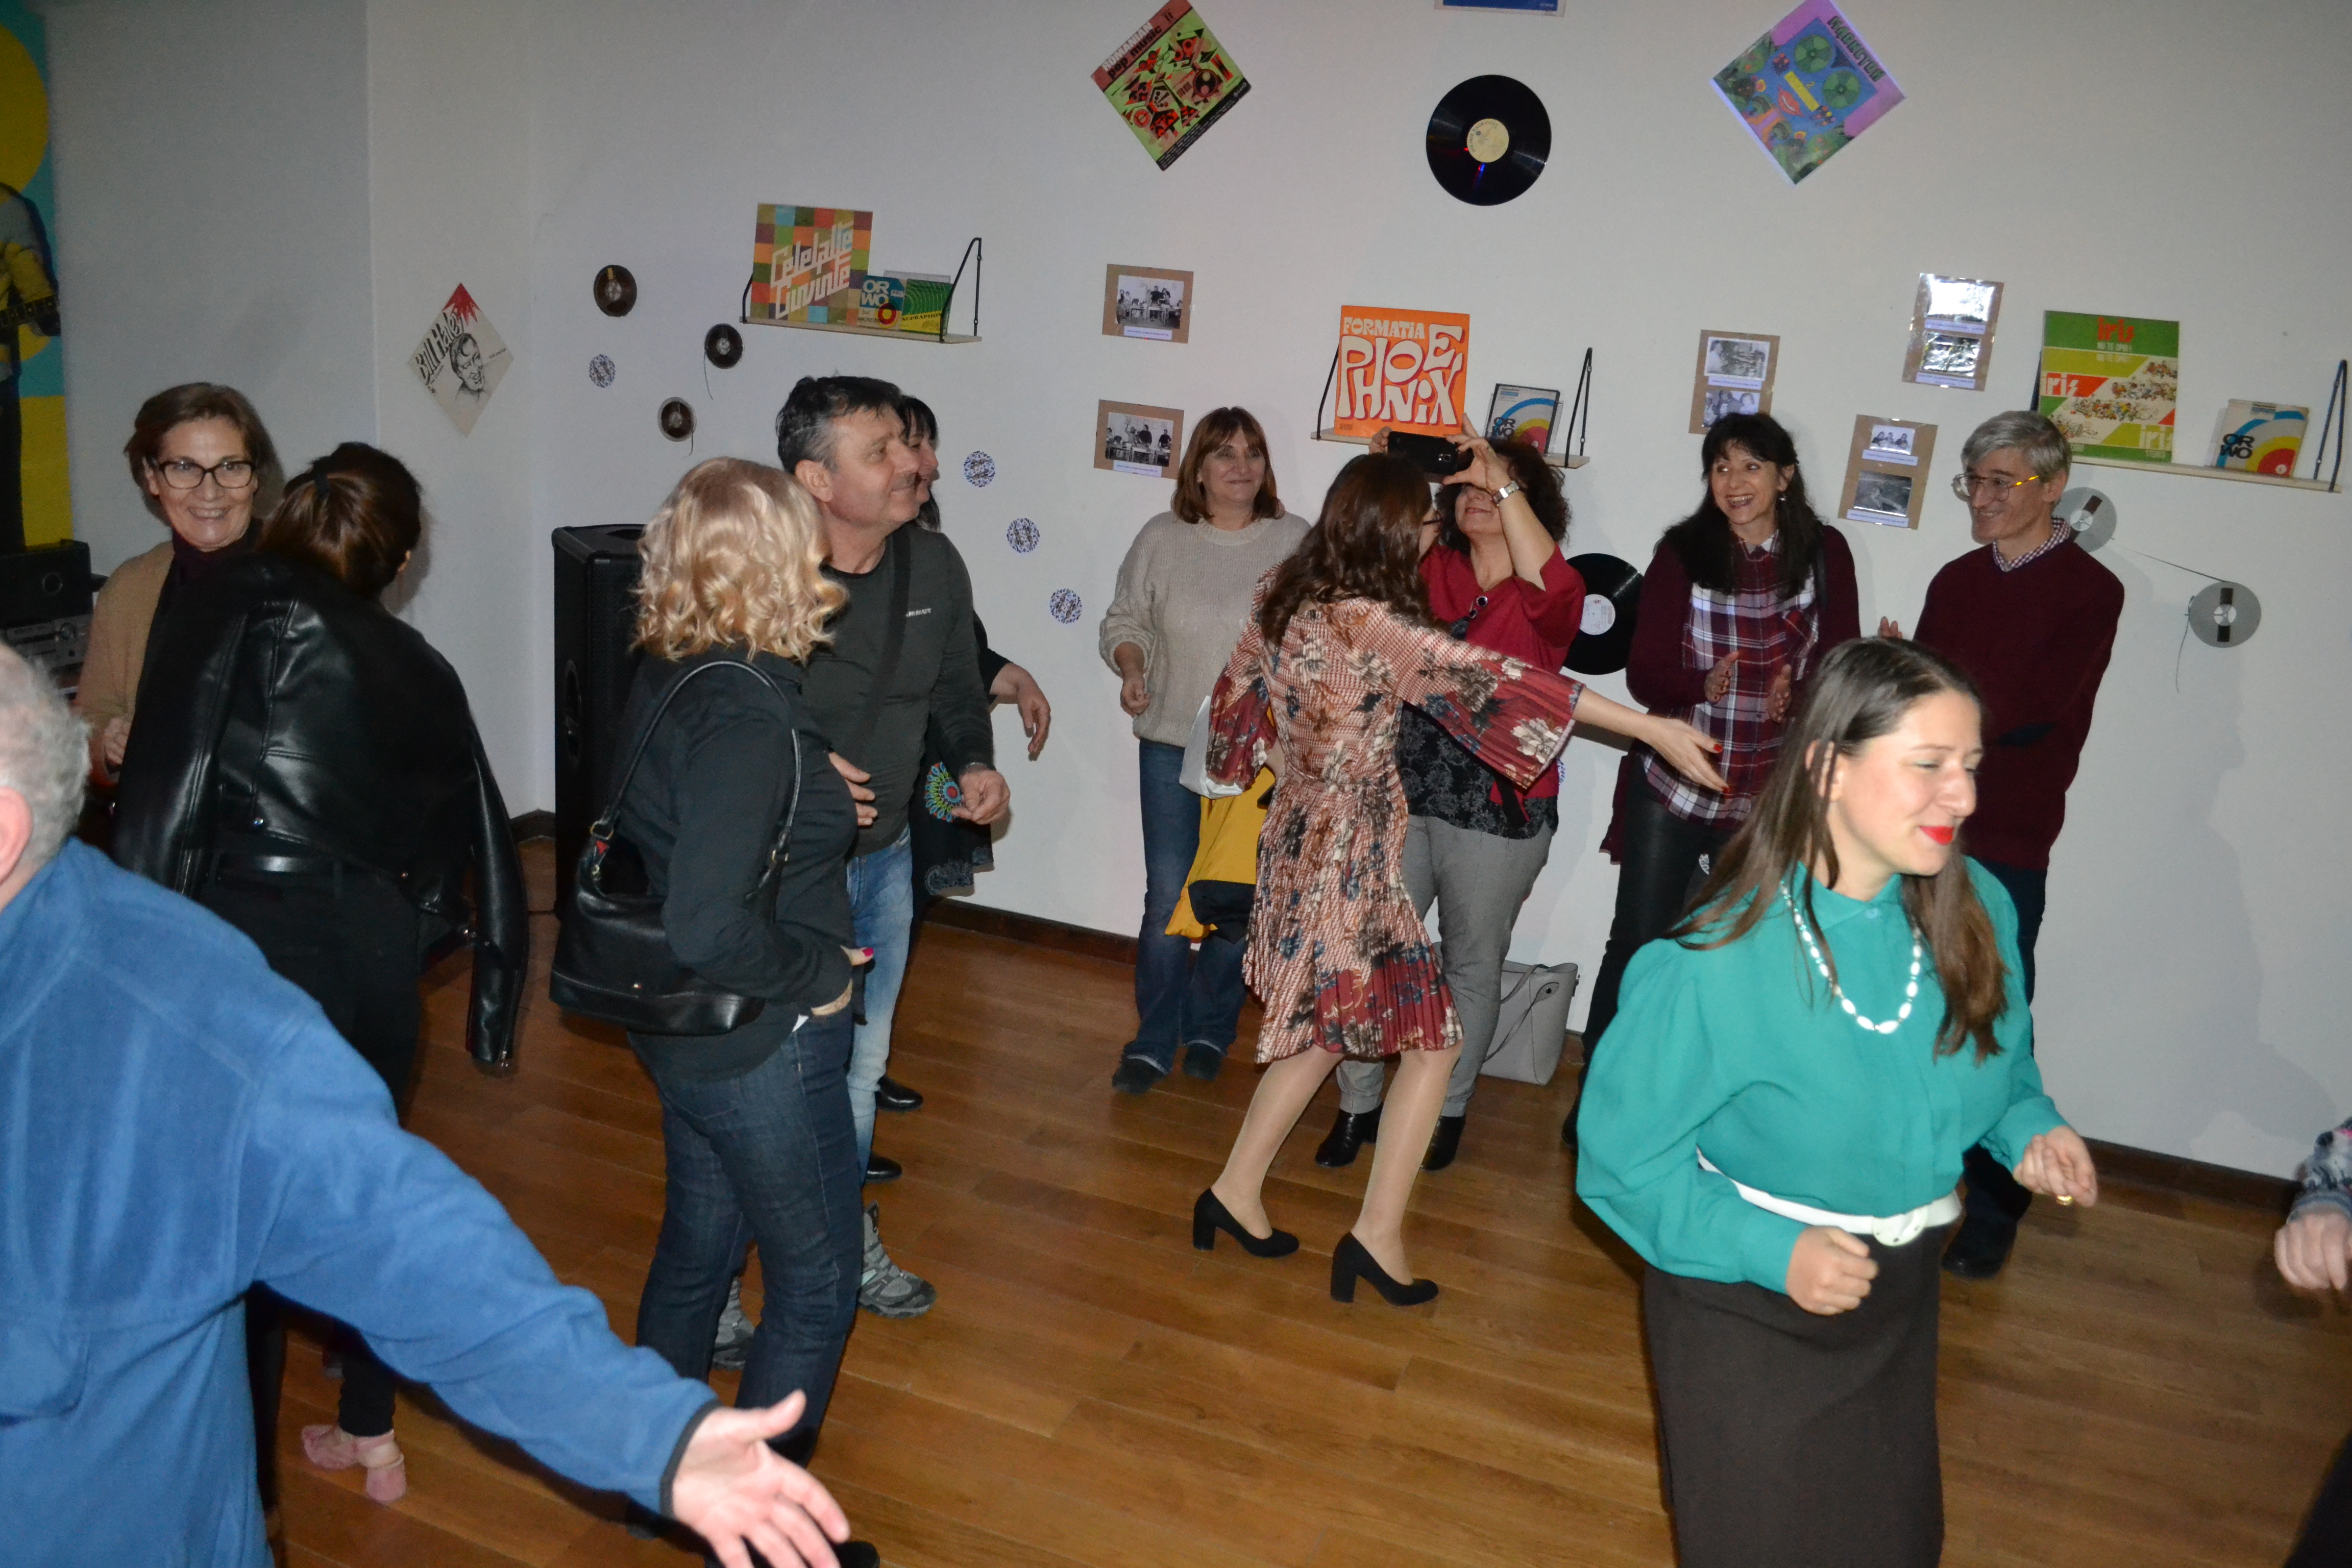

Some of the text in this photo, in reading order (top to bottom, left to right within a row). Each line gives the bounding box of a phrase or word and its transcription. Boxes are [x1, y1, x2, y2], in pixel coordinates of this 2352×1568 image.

[1101, 21, 1154, 72] ROMANIAN
[1107, 26, 1162, 80] pop music
[863, 279, 890, 295] OR
[861, 292, 889, 307] WO
[415, 338, 441, 386] Bill
[1493, 416, 1516, 428] OR
[2223, 433, 2255, 448] OR
[2220, 444, 2253, 459] WO
